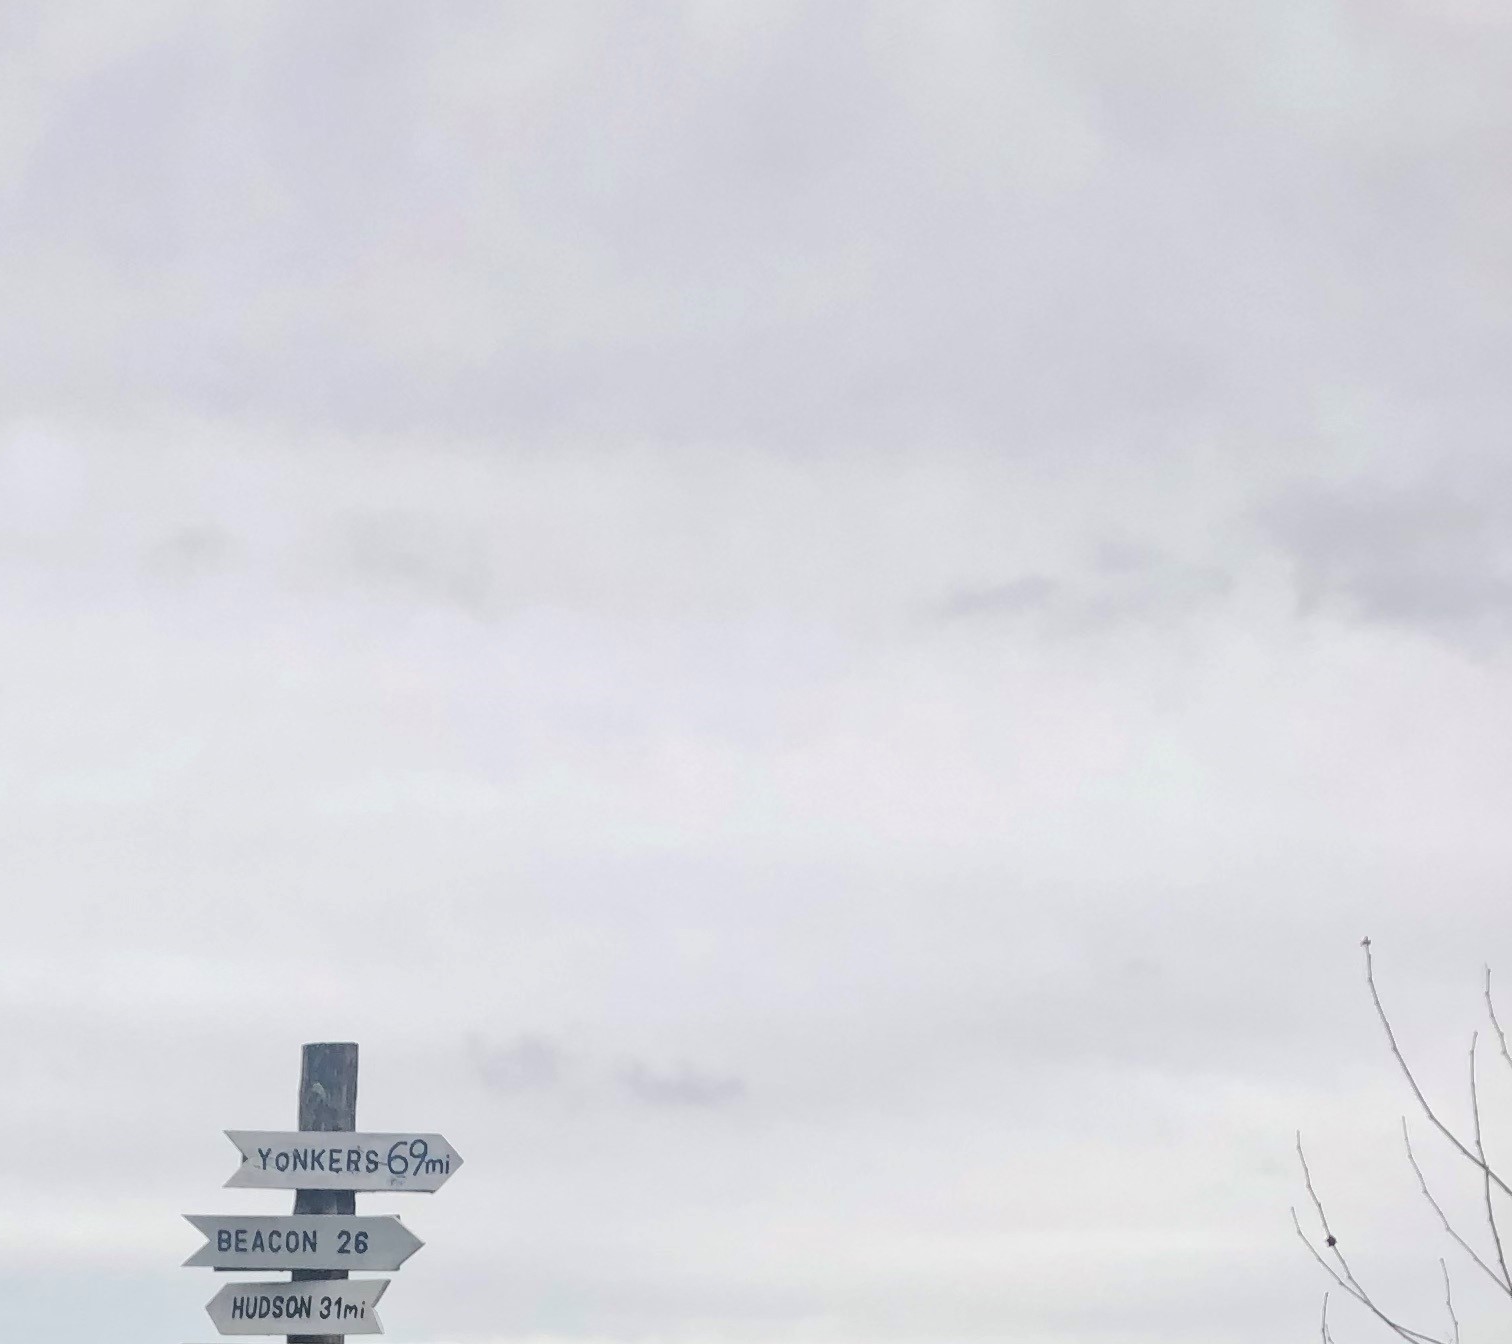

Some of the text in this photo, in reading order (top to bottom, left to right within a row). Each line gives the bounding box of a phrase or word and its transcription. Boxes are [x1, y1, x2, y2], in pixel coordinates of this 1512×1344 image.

[217, 1230, 369, 1254] BEACON 26
[232, 1297, 311, 1319] HUDSON
